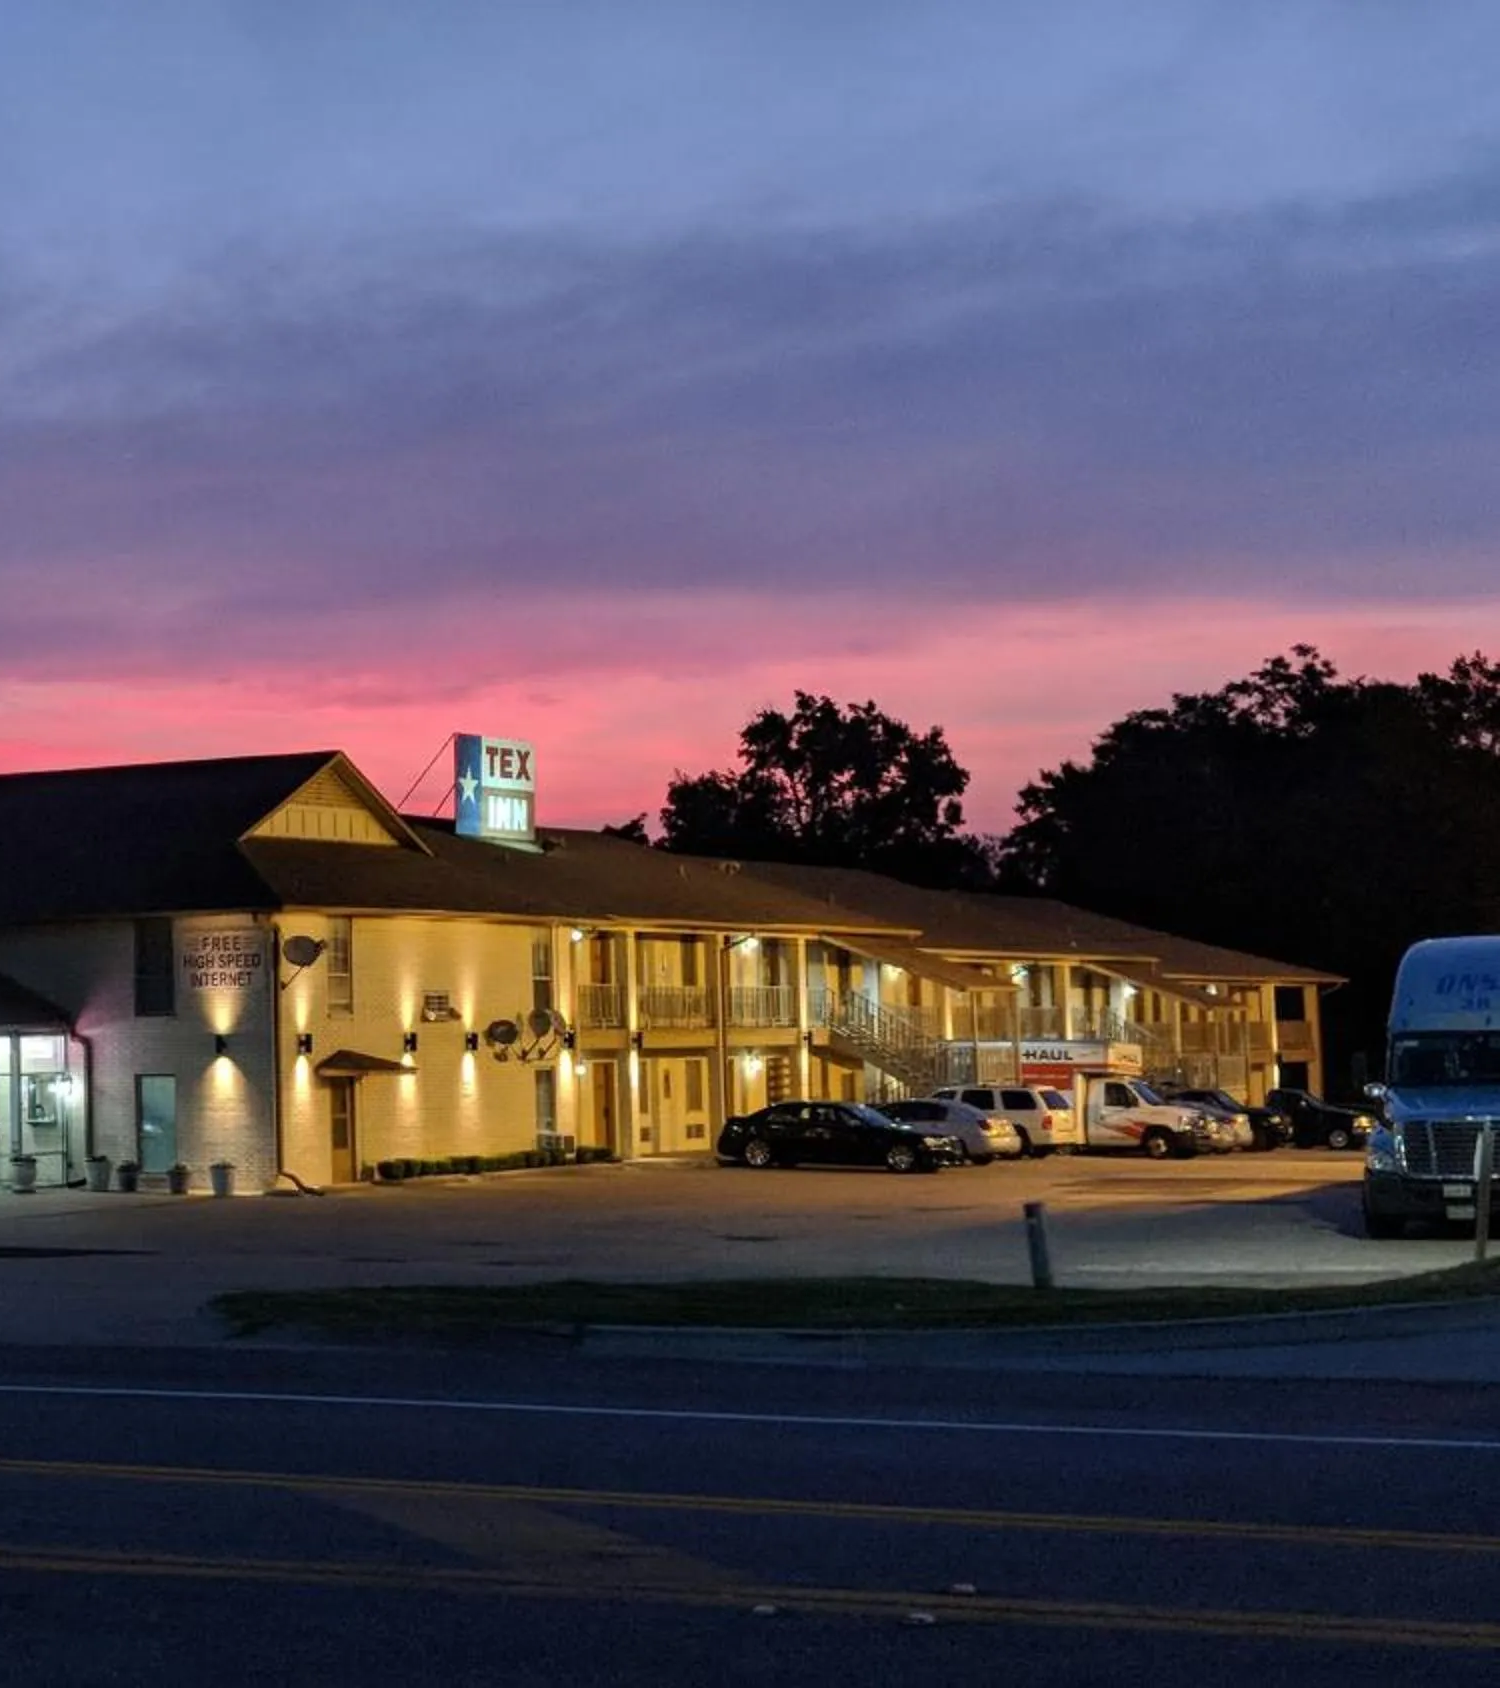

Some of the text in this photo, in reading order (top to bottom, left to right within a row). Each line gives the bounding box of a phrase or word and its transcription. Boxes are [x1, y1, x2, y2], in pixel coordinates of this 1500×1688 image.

[486, 746, 531, 780] TEX
[488, 795, 528, 831] INN
[202, 936, 241, 951] FREE
[218, 953, 261, 968] SPEED
[190, 971, 252, 987] INTERNET
